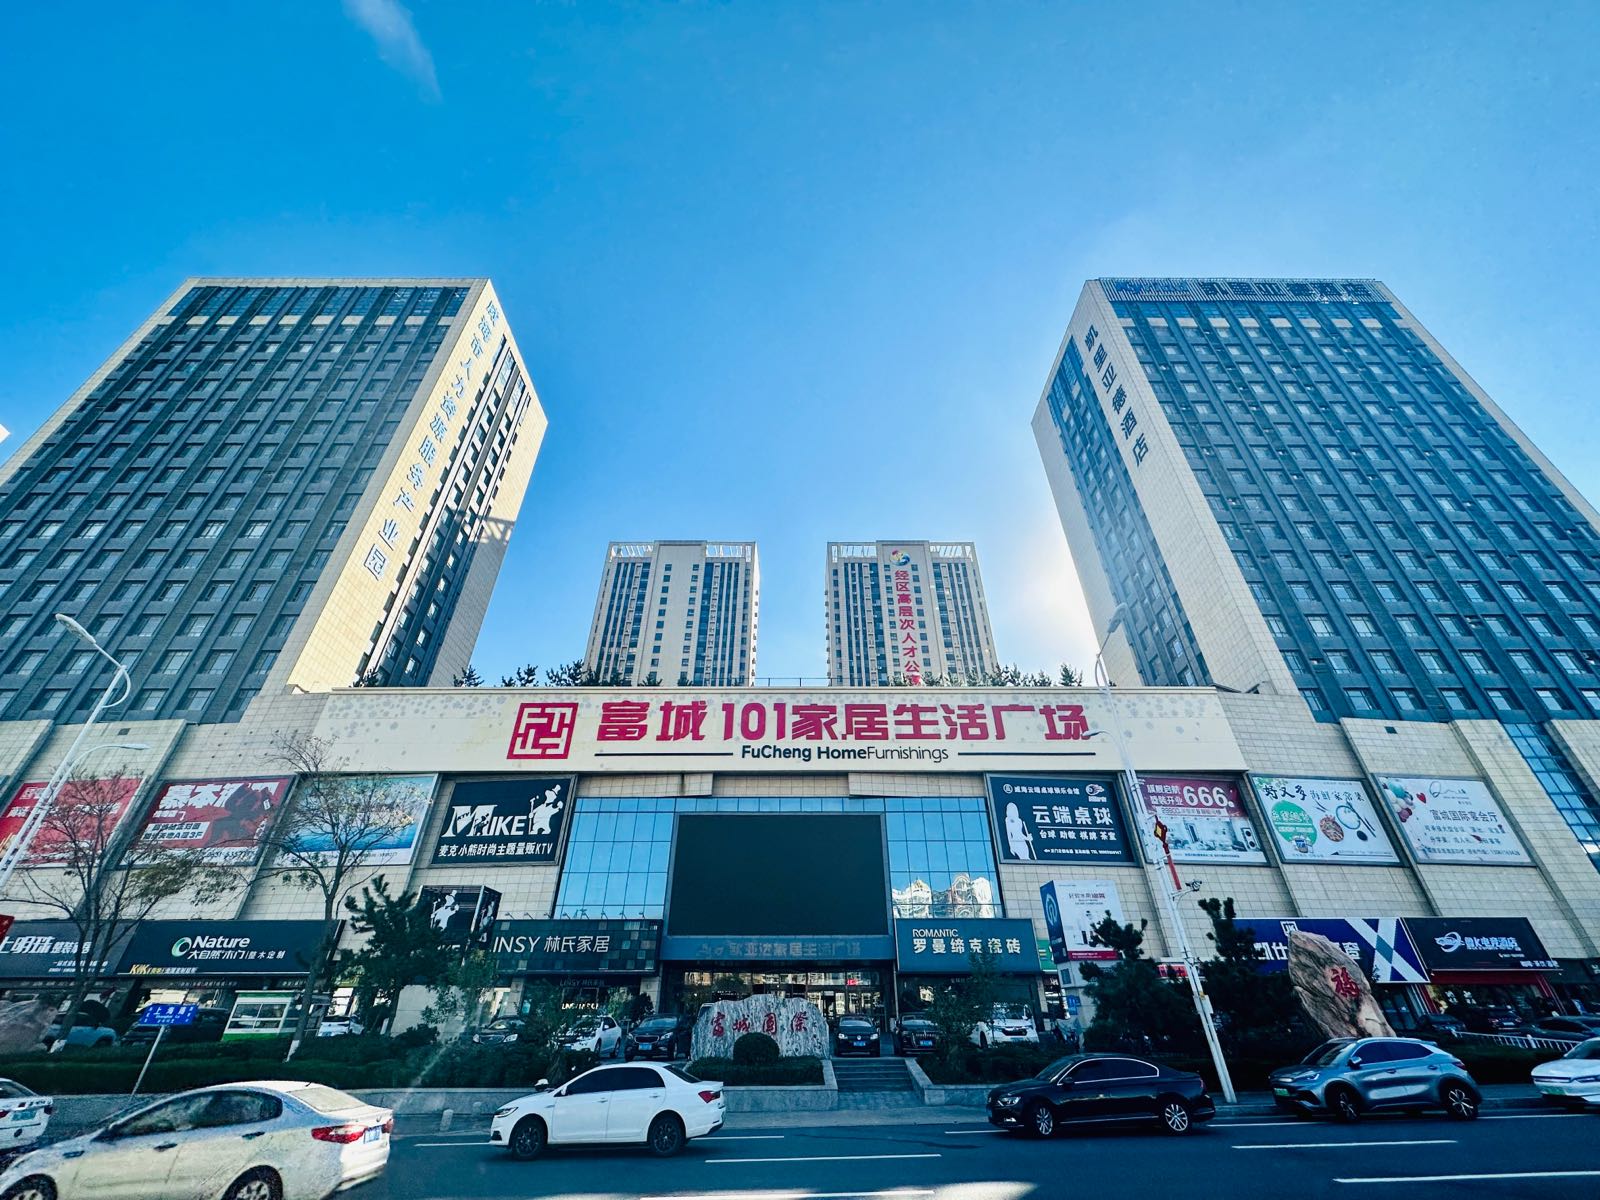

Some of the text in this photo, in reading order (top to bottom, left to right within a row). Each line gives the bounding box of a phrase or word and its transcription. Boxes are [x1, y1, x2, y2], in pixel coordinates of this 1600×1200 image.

[1084, 325, 1149, 467] 凯里亚德酒店
[597, 700, 1091, 741] 富城101家居生活广场
[742, 745, 811, 762] FuCheng
[1263, 785, 1307, 800] 好又多
[1032, 805, 1114, 825] 云端桌球
[438, 842, 553, 857] 麦克小熊时尚主题量贩KTV
[912, 929, 958, 937] ROMANTIC
[192, 936, 250, 948] Nature
[544, 936, 610, 953] 林氏家居
[913, 938, 1021, 954] 罗曼缔克瓷砖
